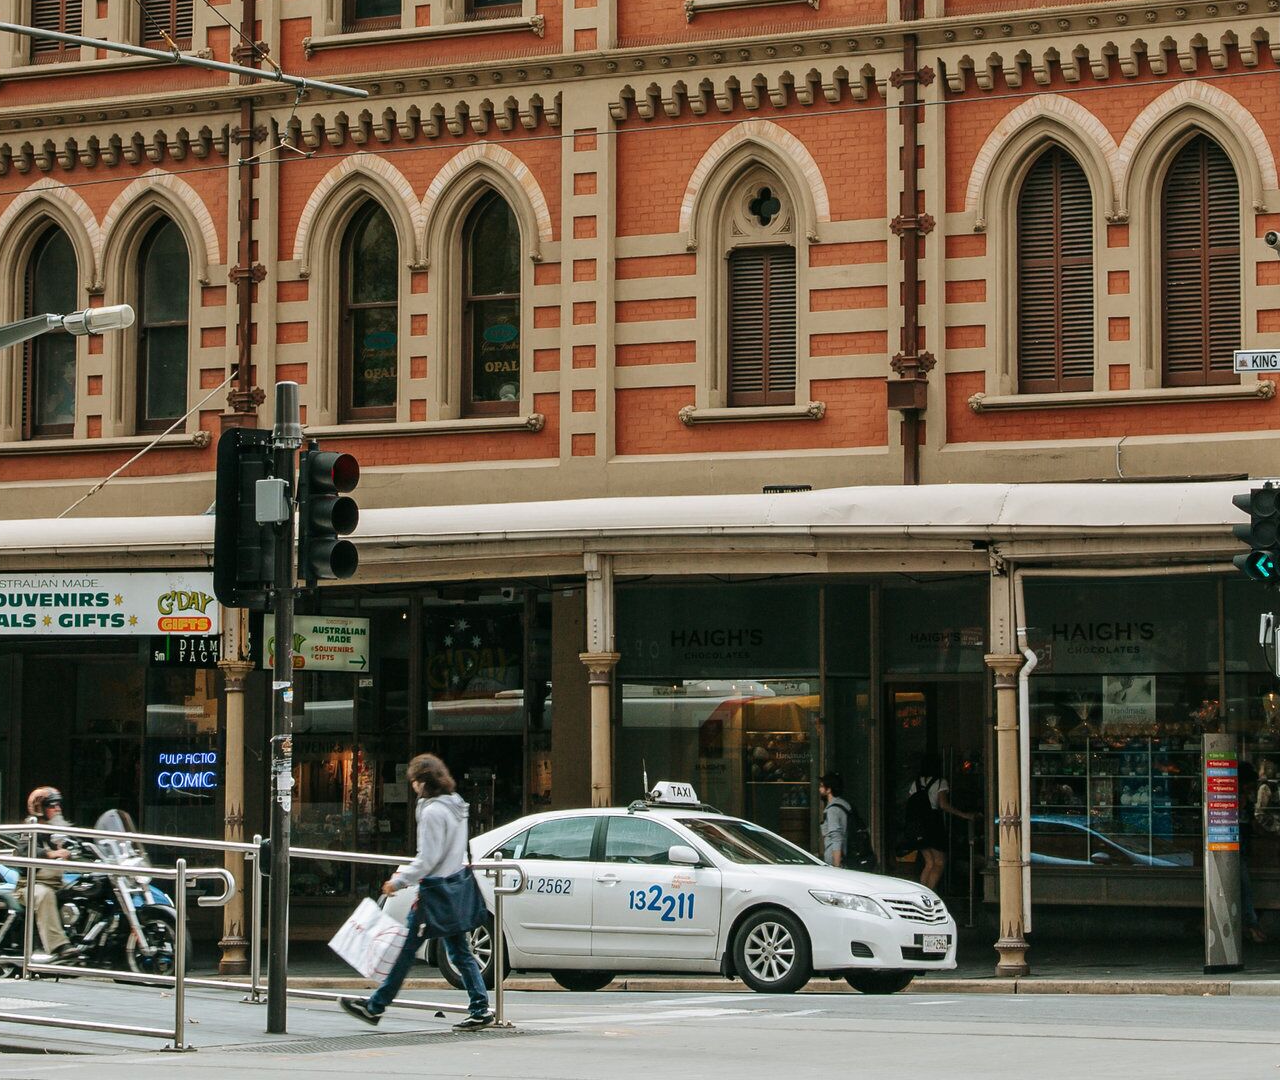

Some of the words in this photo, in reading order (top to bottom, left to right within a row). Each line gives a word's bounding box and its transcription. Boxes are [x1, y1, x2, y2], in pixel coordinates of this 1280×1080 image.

[1252, 354, 1278, 368] KING
[58, 613, 125, 628] GIFTS
[162, 618, 208, 631] GIFTS
[312, 626, 366, 635] AUSTRALIAN
[1052, 622, 1154, 640] HAIGH'S
[327, 635, 351, 643] MADE
[314, 645, 354, 653] SOUVENIRS
[1067, 646, 1140, 654] CHOCOLATES
[684, 651, 750, 660] CHOCOLATES
[160, 753, 183, 764] PULP
[185, 752, 216, 764] FICTIO
[670, 786, 691, 797] TAXI
[512, 879, 533, 891] TXI
[537, 878, 572, 894] 2562
